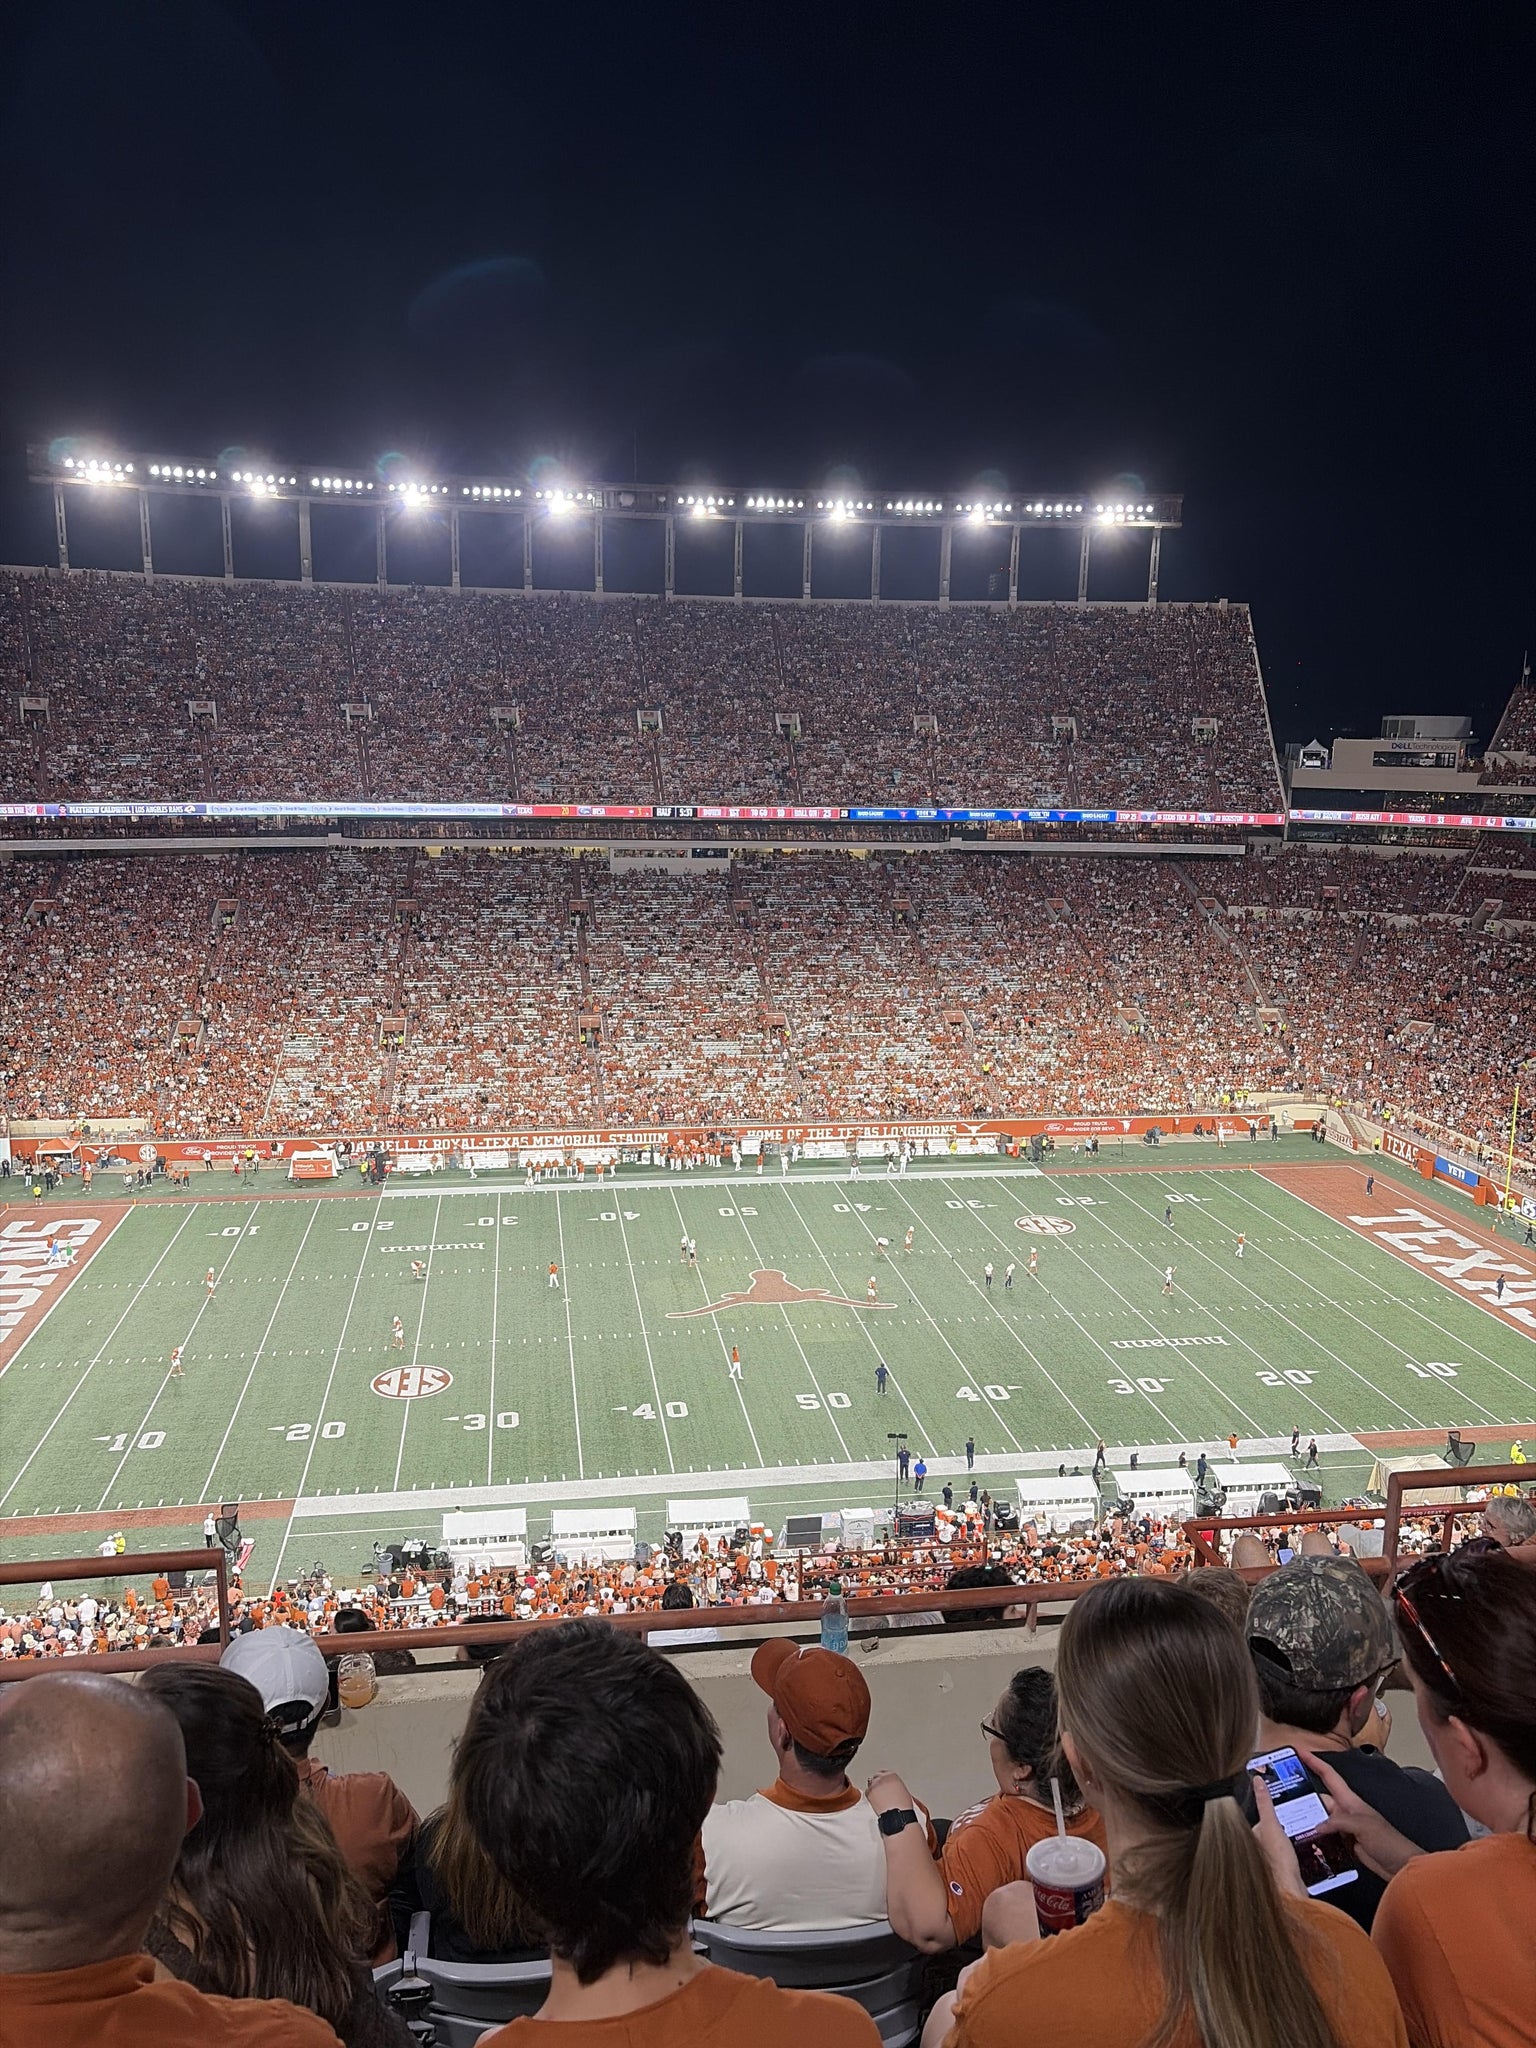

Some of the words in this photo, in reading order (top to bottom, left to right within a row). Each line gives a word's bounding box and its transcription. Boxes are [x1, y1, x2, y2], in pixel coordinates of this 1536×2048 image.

[1412, 743, 1457, 751] Technologies
[69, 806, 100, 814] MATTHEW
[135, 805, 145, 813] LOS
[168, 805, 183, 813] RAMS
[656, 808, 672, 816] HALF
[418, 1139, 428, 1150] K
[433, 1136, 528, 1150] ROYAL-TEXAS
[532, 1134, 601, 1146] MEMORIAL
[609, 1132, 669, 1144] STADIUM
[747, 1129, 783, 1141] HOME
[787, 1128, 803, 1140] OF
[807, 1128, 833, 1138] THE
[838, 1126, 879, 1138] TEAS
[883, 1125, 957, 1137] LONGHORNS
[1447, 1163, 1466, 1180] YETI
[944, 1199, 985, 1209] 30
[1055, 1196, 1095, 1206] 20
[1164, 1193, 1202, 1204] 10
[600, 1211, 641, 1221] 40
[718, 1207, 758, 1217] 50
[833, 1203, 871, 1213] 40
[351, 1221, 395, 1232] 20
[477, 1215, 519, 1226] 30
[1016, 1216, 1075, 1234] SEC
[221, 1225, 261, 1237] 10
[1346, 1208, 1536, 1328] TEXA
[1255, 1369, 1311, 1386] 20
[1405, 1361, 1458, 1378] 10
[372, 1366, 452, 1398] SEC
[1107, 1377, 1165, 1394] 30
[796, 1392, 852, 1410] 50
[955, 1384, 1011, 1402] 40
[631, 1401, 689, 1420] 40
[462, 1411, 520, 1431] 30
[284, 1420, 347, 1441] 20
[107, 1430, 167, 1452] 10
